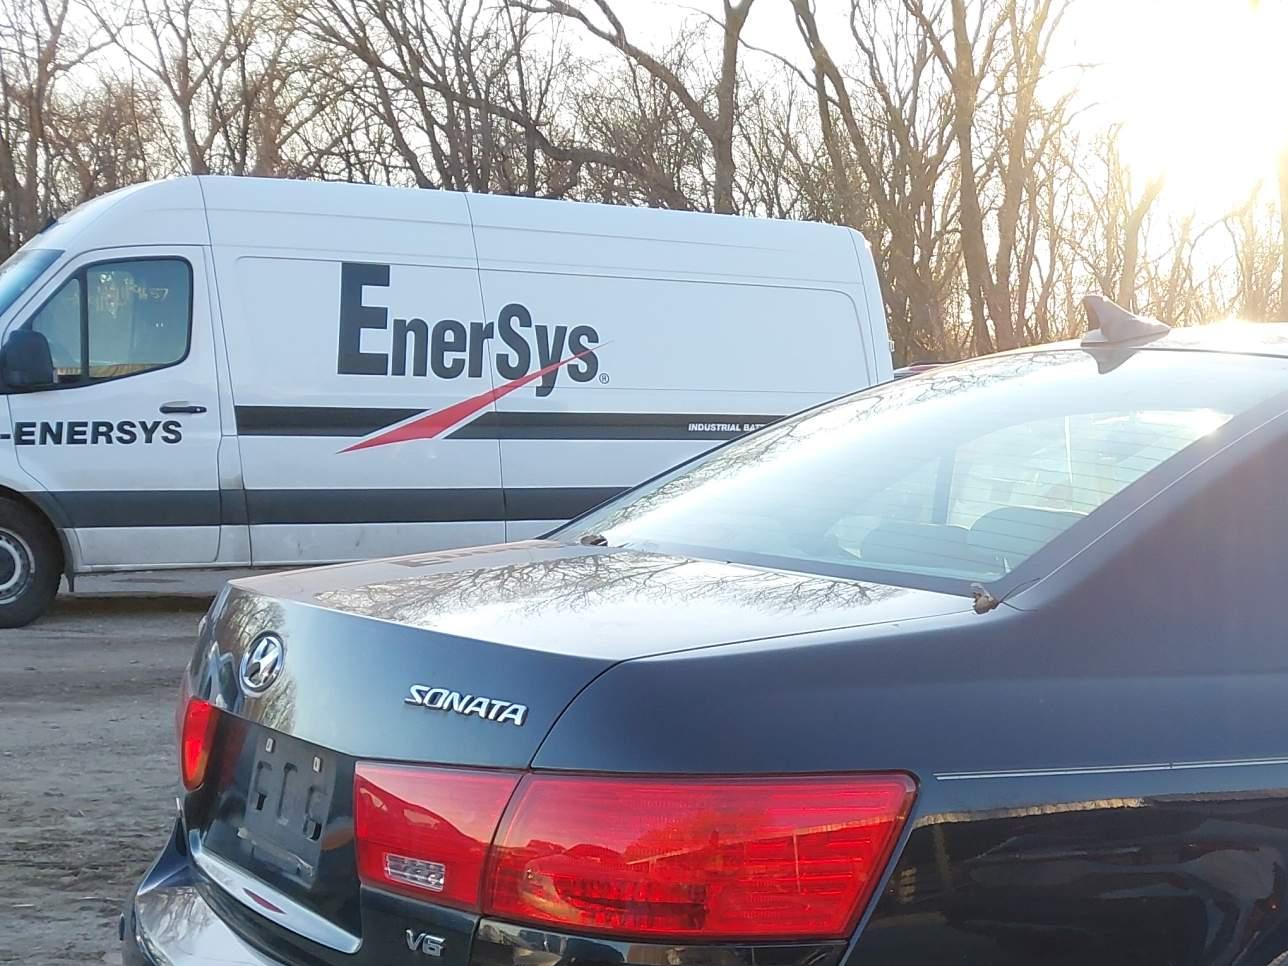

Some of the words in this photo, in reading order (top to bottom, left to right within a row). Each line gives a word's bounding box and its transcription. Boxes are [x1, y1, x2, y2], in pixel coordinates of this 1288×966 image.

[688, 423, 741, 432] INDUSTRIAL
[404, 684, 529, 726] SONATA
[406, 929, 446, 957] V6
